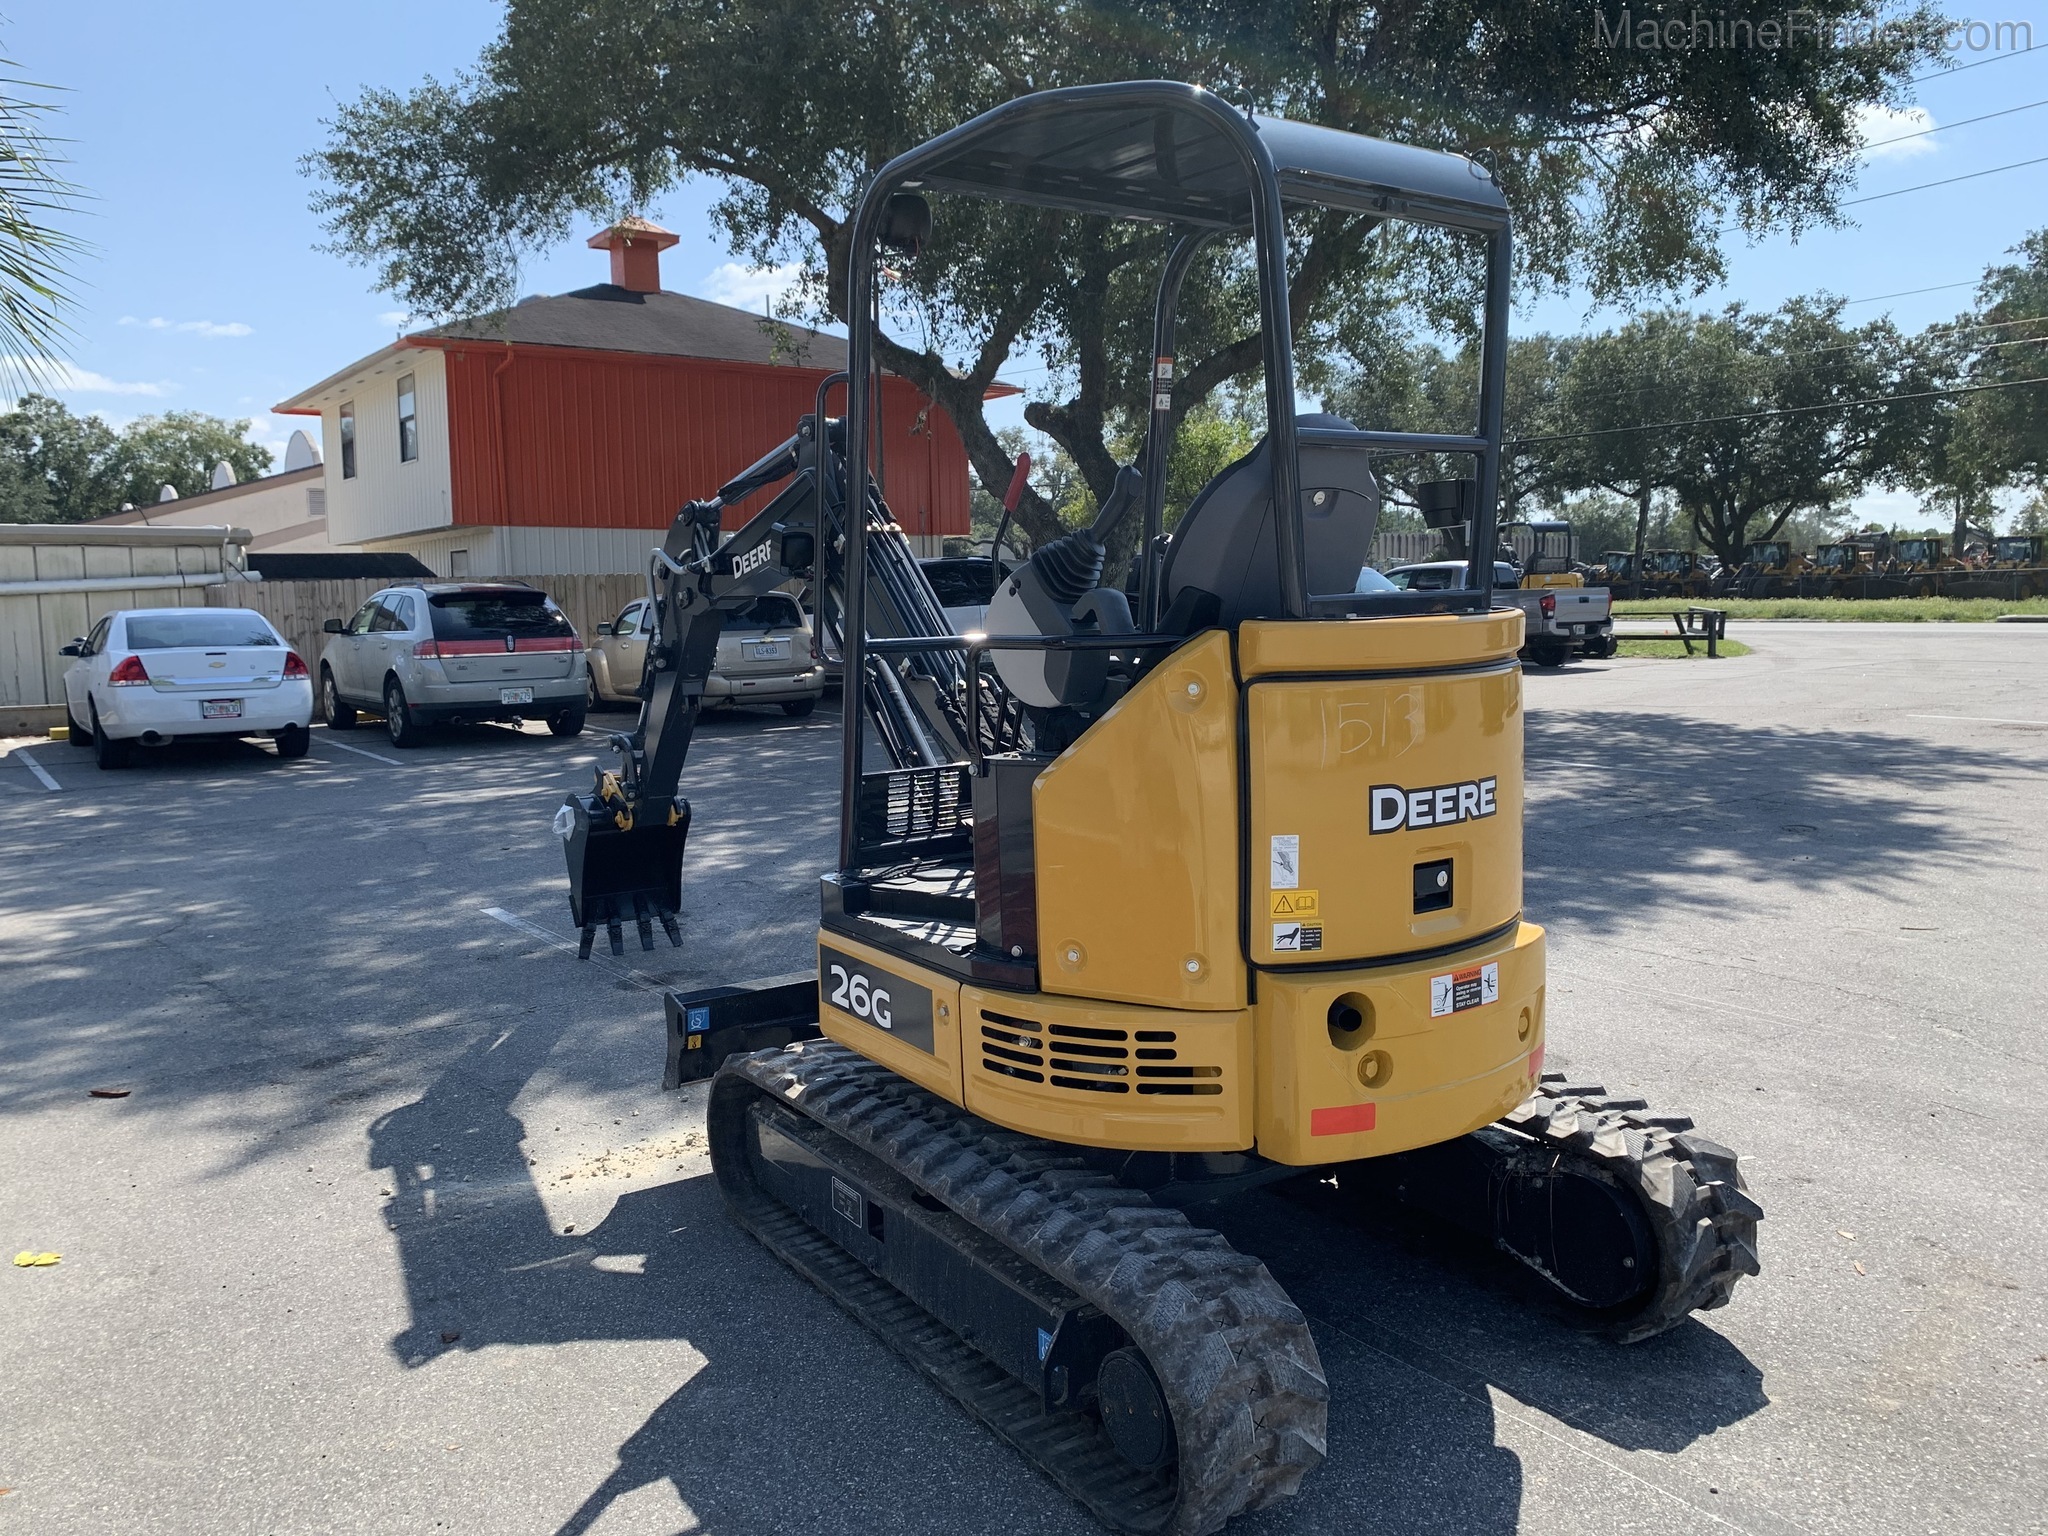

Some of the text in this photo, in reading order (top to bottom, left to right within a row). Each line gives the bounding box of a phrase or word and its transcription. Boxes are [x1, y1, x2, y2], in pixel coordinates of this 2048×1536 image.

[1371, 777, 1496, 833] DEERE
[830, 964, 892, 1029] 26G
[1459, 968, 1482, 980] WARNING
